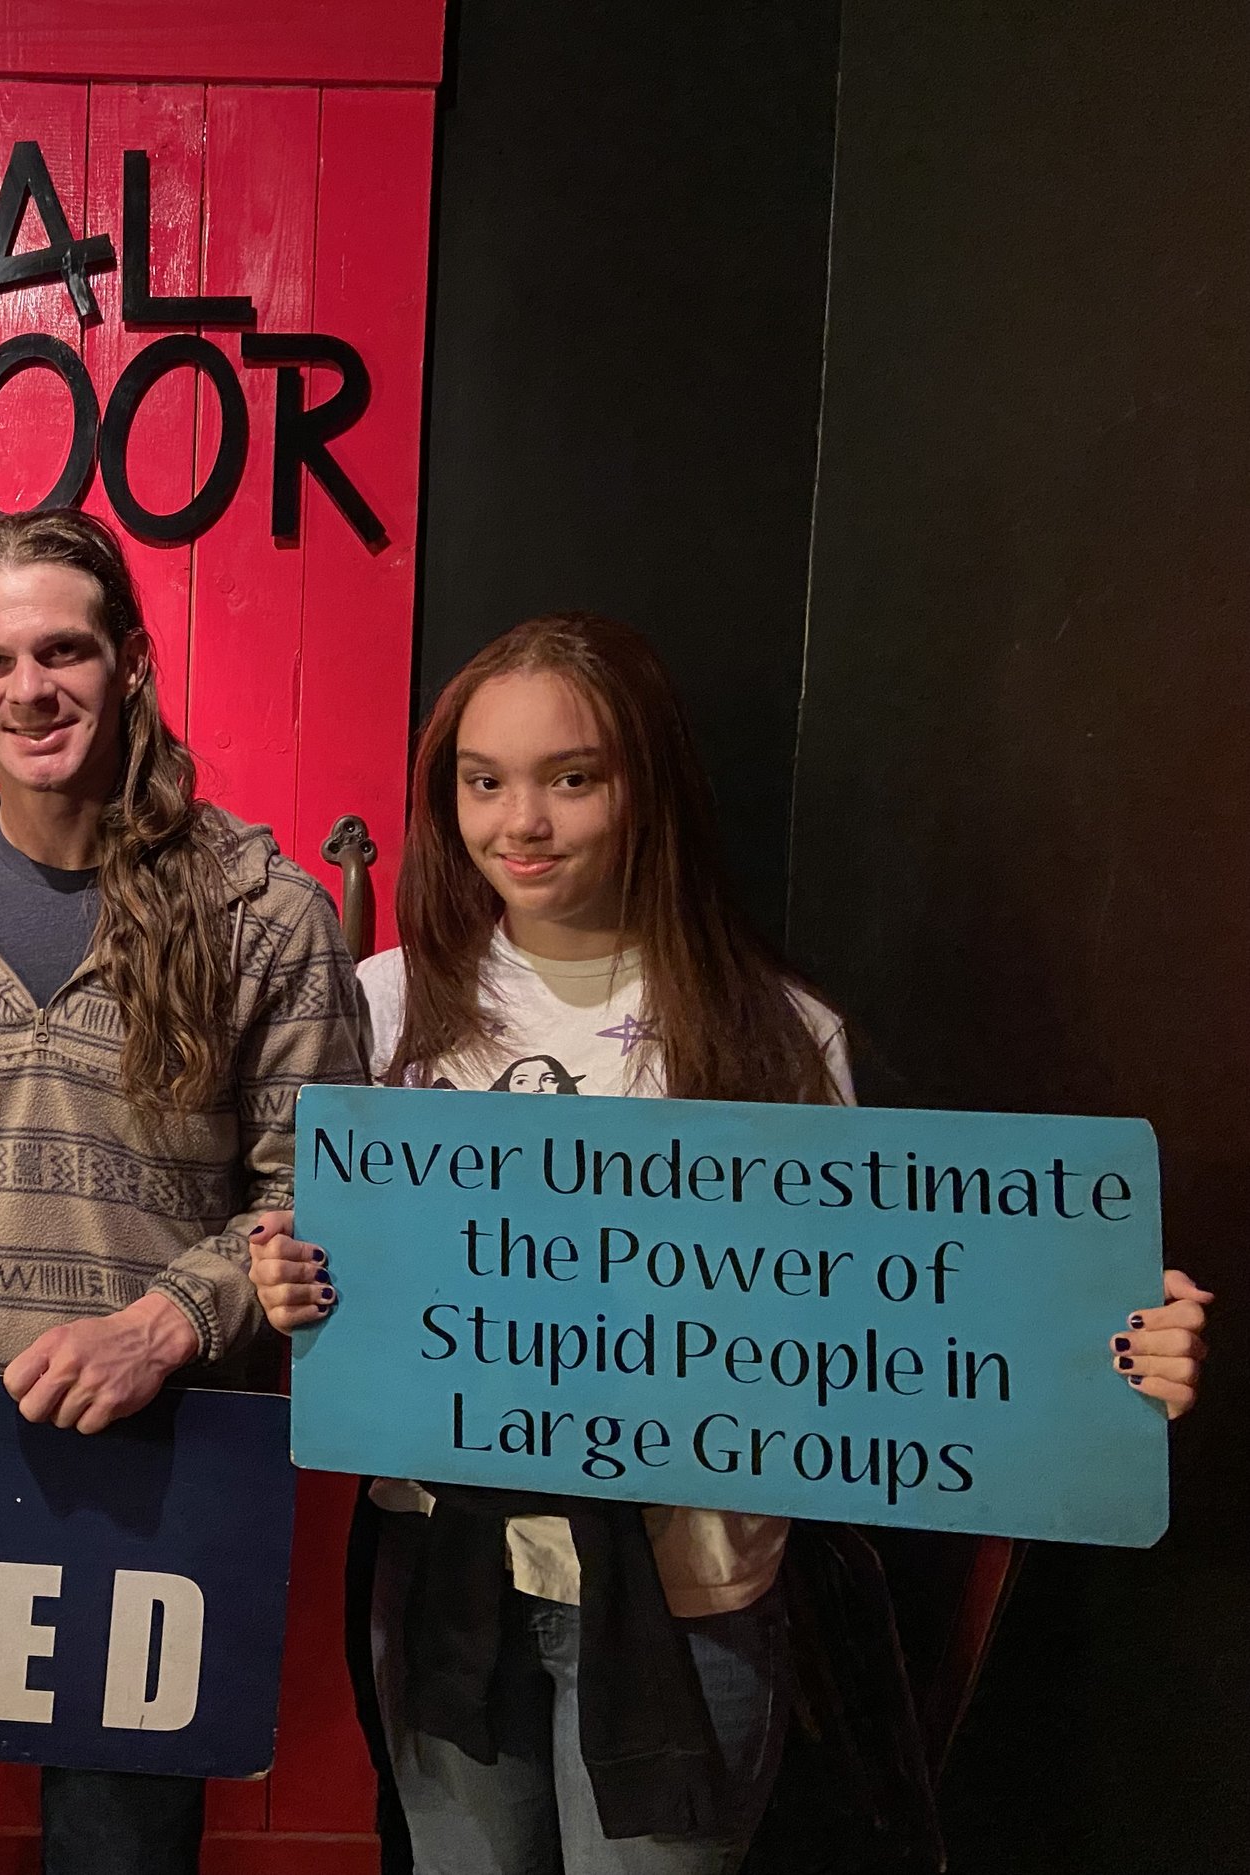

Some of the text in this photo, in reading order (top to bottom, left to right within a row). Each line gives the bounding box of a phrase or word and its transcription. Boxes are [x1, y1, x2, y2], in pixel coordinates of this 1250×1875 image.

[313, 1127, 1133, 1222] Never Underestimate
[461, 1218, 965, 1304] the Power of
[421, 1303, 1011, 1406] Stupid People in
[453, 1392, 974, 1505] Large Groups
